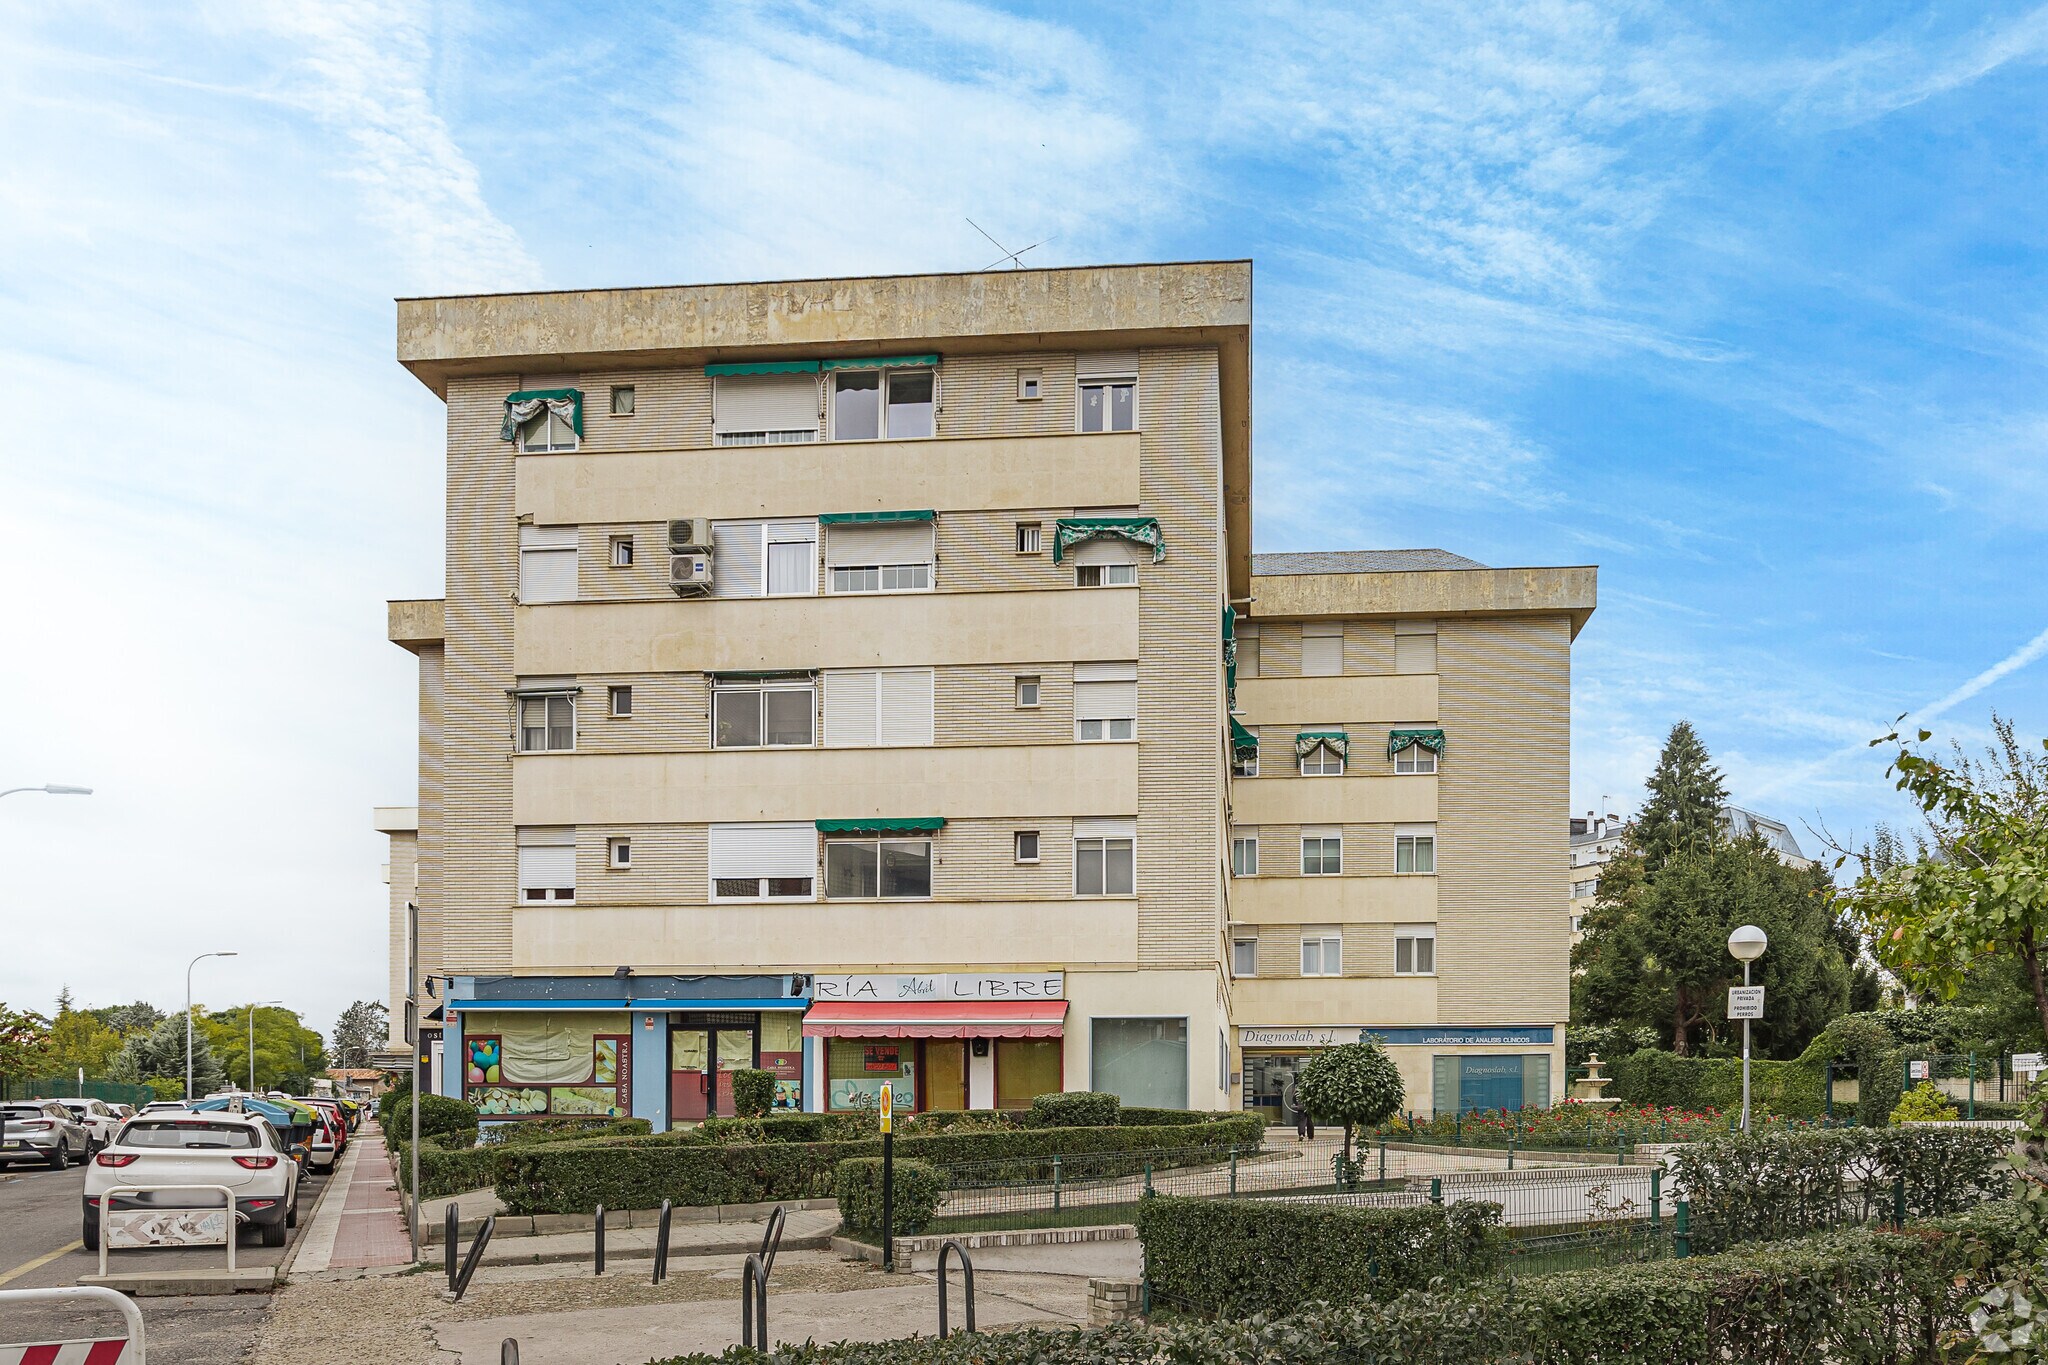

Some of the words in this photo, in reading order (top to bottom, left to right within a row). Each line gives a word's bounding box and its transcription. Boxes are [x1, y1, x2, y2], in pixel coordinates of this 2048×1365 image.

[816, 975, 878, 997] RÍA
[899, 977, 936, 997] Abril
[954, 979, 1061, 996] LIBRE
[1244, 1029, 1315, 1045] Diagnoslab,
[864, 1046, 874, 1055] SE
[875, 1046, 899, 1055] VENDE
